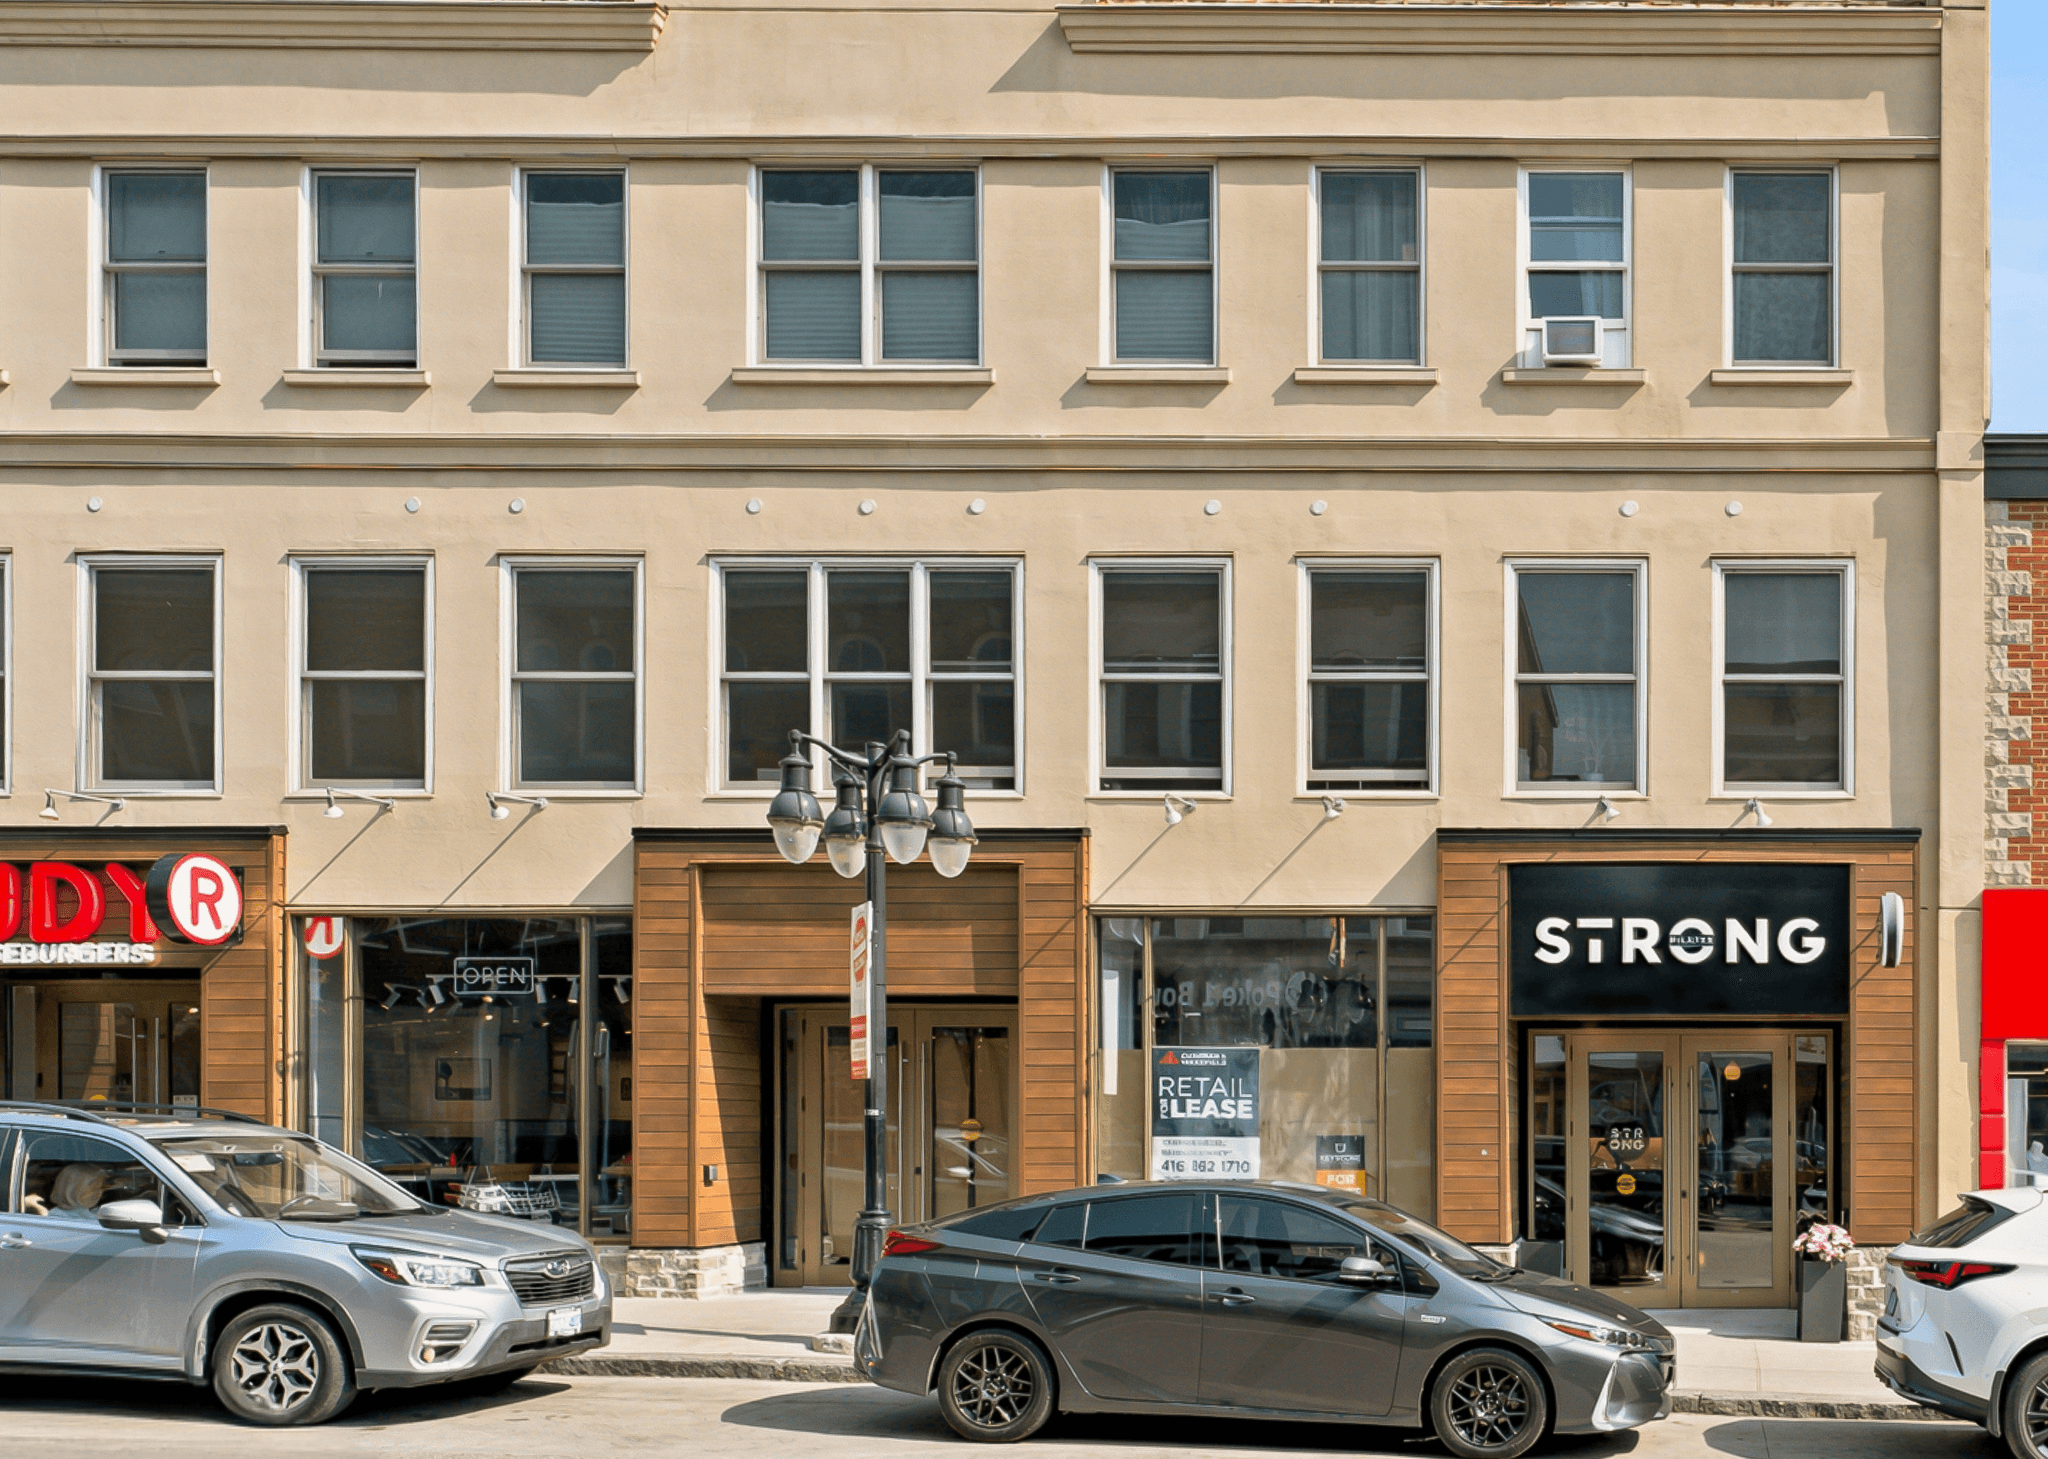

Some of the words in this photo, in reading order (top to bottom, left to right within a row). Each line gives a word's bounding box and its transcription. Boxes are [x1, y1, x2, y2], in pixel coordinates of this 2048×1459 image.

[0, 861, 163, 943] DY
[1534, 917, 1826, 964] STRONG
[0, 943, 155, 964] EBURGERS
[463, 967, 526, 984] OPEN
[1159, 1076, 1253, 1098] RETAIL
[1170, 1098, 1254, 1119] LEASE
[1609, 1139, 1645, 1150] ONG
[1327, 1174, 1355, 1185] FOR
